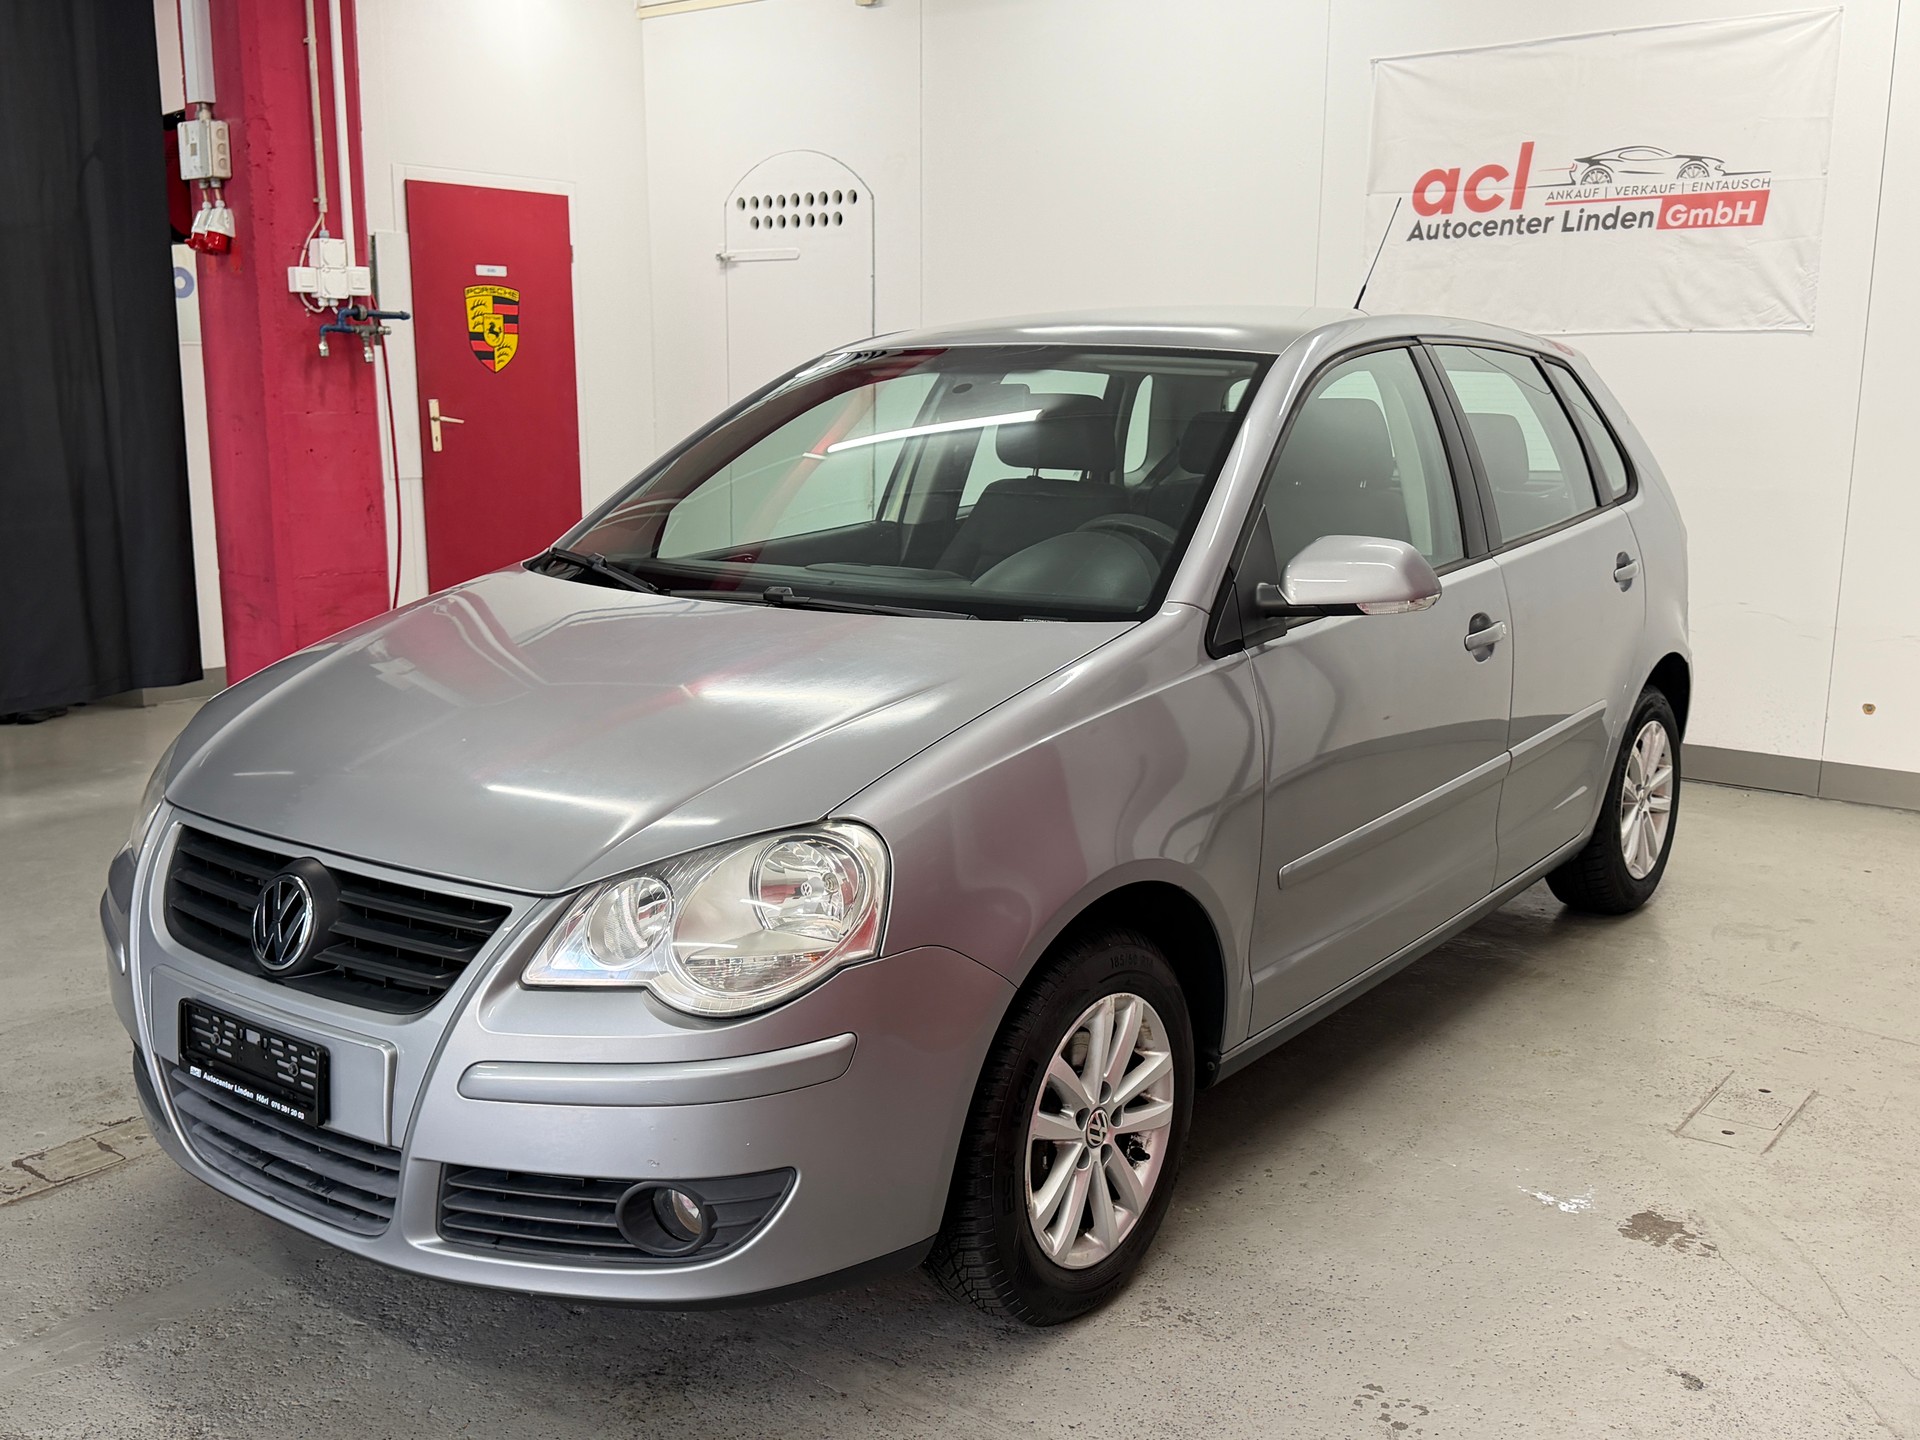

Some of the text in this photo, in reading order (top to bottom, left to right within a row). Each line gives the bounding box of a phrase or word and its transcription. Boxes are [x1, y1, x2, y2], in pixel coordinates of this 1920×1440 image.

[1412, 141, 1535, 216] acl
[1546, 177, 1772, 201] ANKAUF VERKAUF EINTAUSCH
[1406, 200, 1758, 242] Autocenter Linden GmbH
[466, 287, 517, 298] PORSCHE
[202, 1071, 234, 1091] Autocenter
[234, 1085, 254, 1099] Linden
[256, 1093, 269, 1105] Höri
